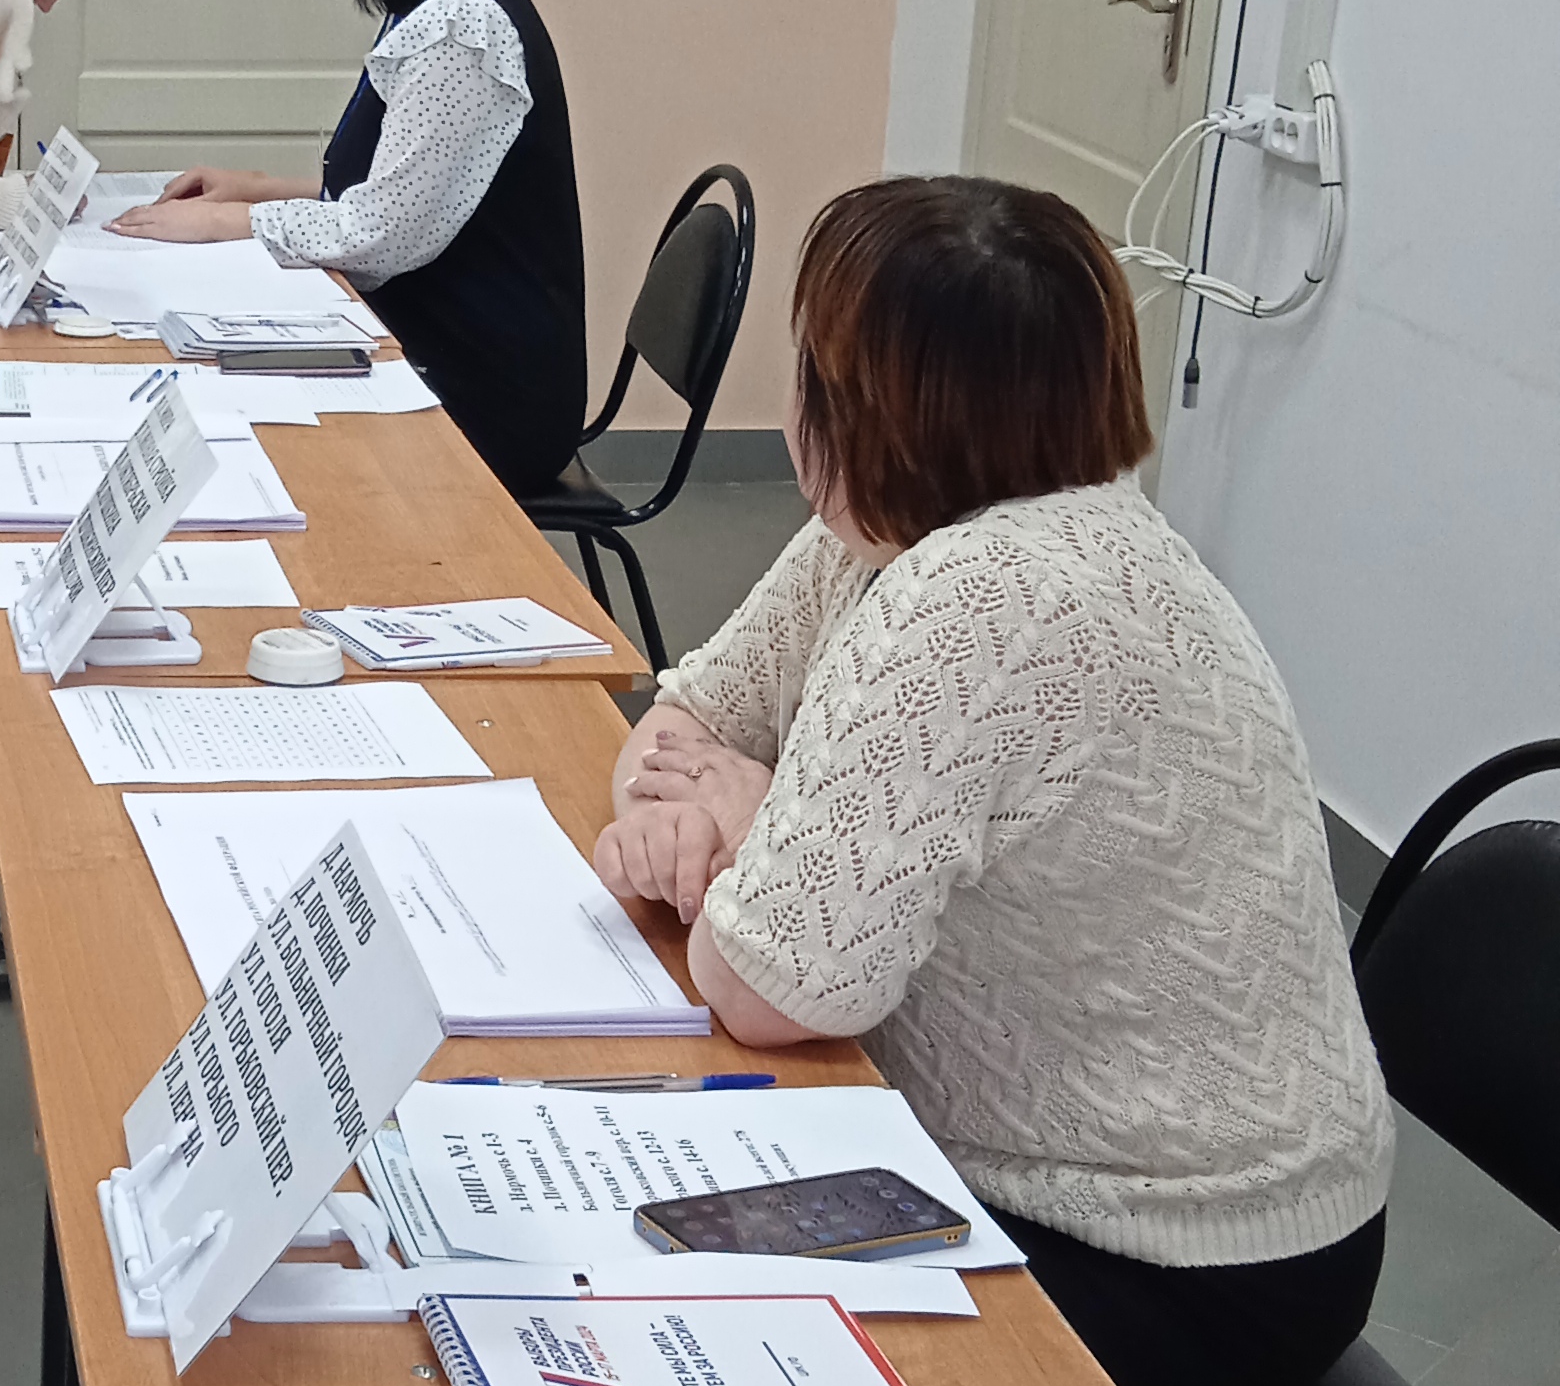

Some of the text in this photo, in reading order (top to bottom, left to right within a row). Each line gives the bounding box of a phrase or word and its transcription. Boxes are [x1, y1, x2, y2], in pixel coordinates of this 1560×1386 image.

[319, 842, 376, 946] Д. НАРМОЧЬ
[290, 876, 350, 987] Д. ПОЧИНКИ
[240, 942, 292, 1055] УЛ. ГОГОЛЯ
[267, 907, 368, 1154] УЛ. БОЛЬНИЧНЫЙ ГОРОДОК
[189, 1013, 240, 1147] УЛ. ГОРЬКОГО
[215, 977, 293, 1198] УЛ. ГОРЬКОВСКИЙ ПЕР.
[162, 1048, 204, 1168] УЛ. ЛЕННА
[447, 1145, 472, 1161] №
[482, 1133, 502, 1147] 1-3
[637, 1131, 664, 1154] 12-13
[676, 1139, 703, 1162] 14-16
[456, 1164, 497, 1215] КНИГА
[498, 1158, 528, 1201] Нармочь
[530, 1157, 562, 1200] Починки
[560, 1159, 599, 1211] Больничный
[603, 1177, 635, 1212] Гоголя
[620, 1150, 665, 1203] рьковский
[514, 1327, 551, 1368] ВЫБОРЫ
[529, 1316, 575, 1373] ПРЕЗИДЕНТА
[649, 1331, 679, 1356] СИЛА
[664, 1315, 705, 1356] РОССИЮ!
[564, 1340, 600, 1378] РОССИИ
[666, 1358, 692, 1375] МЫ
[692, 1359, 714, 1370] ЗА
